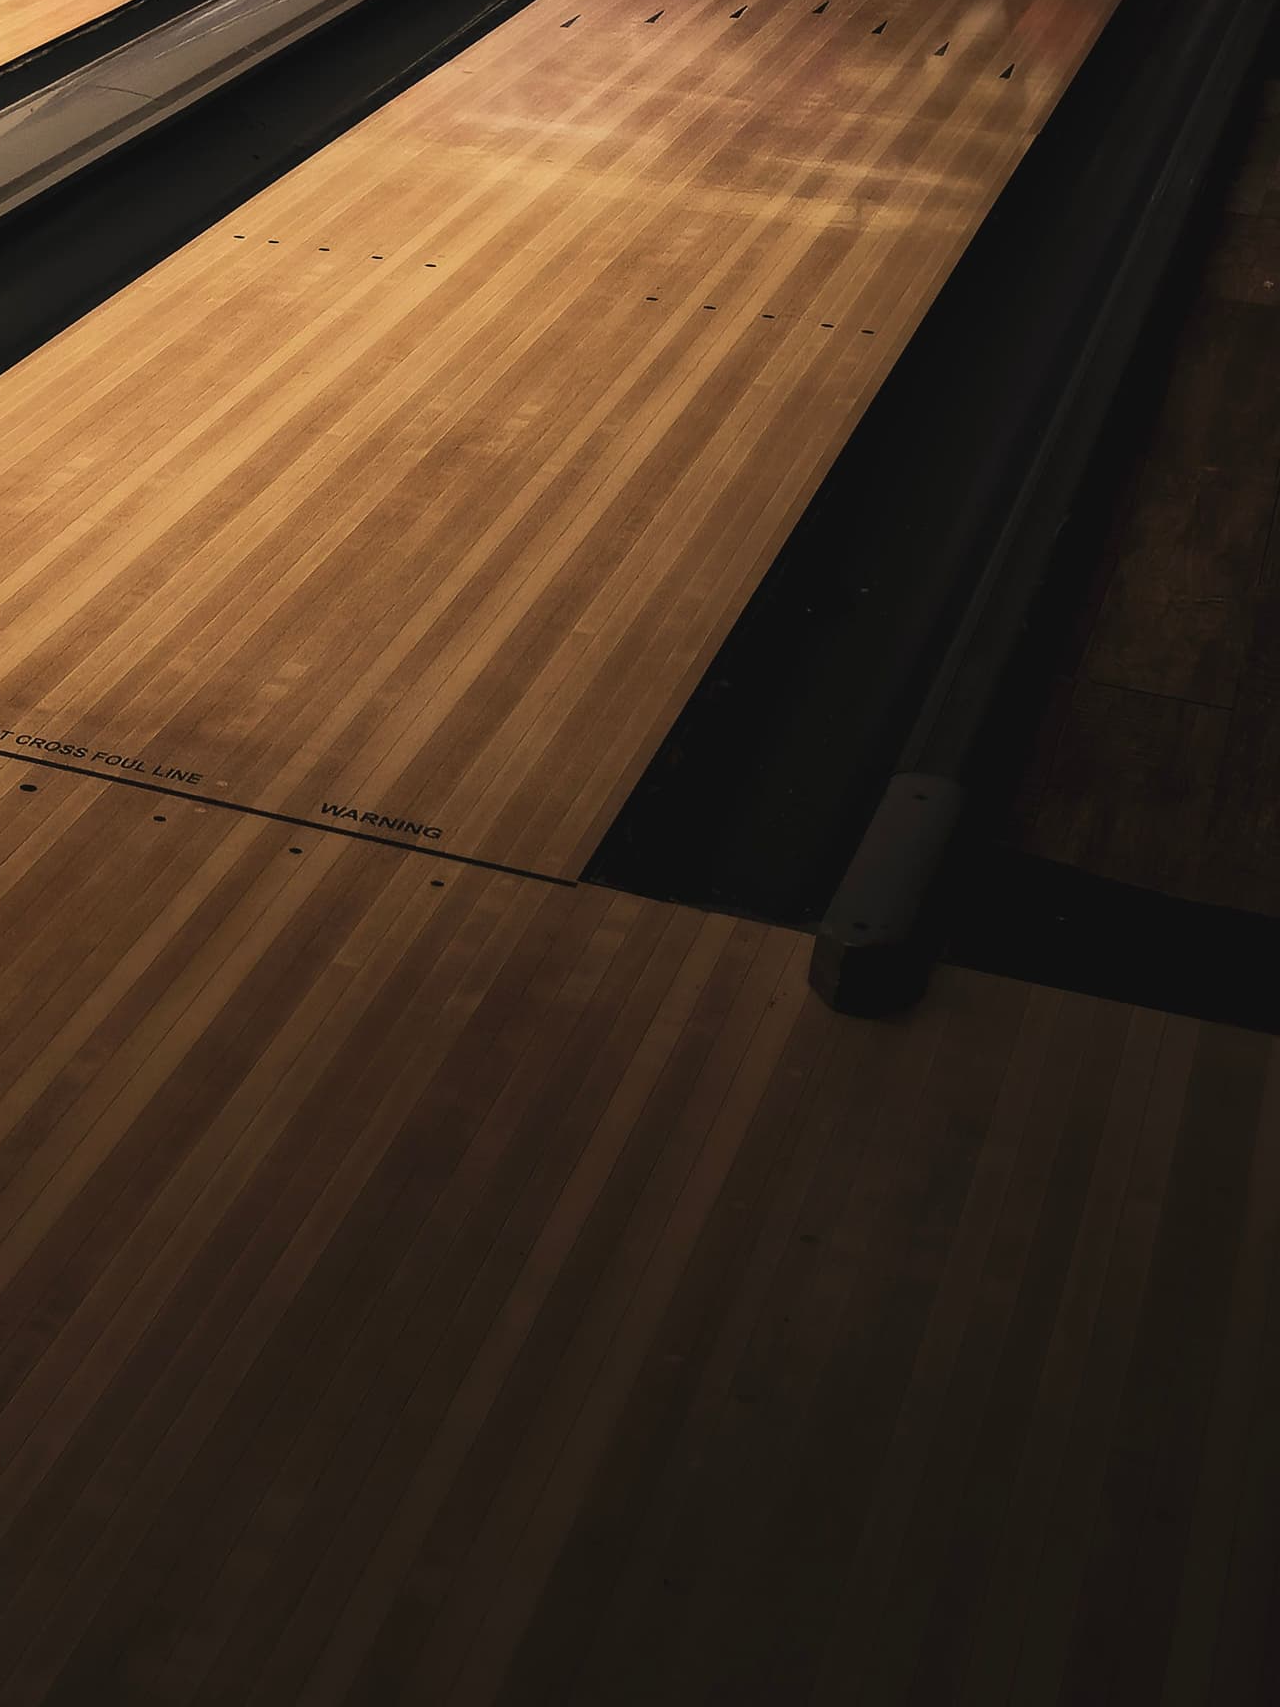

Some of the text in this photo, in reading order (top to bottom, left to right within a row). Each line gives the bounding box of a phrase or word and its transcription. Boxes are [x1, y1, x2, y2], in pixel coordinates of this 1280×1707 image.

[15, 734, 89, 758] CROSS
[90, 750, 147, 774] FOUL
[152, 763, 205, 785] LINE
[320, 802, 443, 840] WARNING
